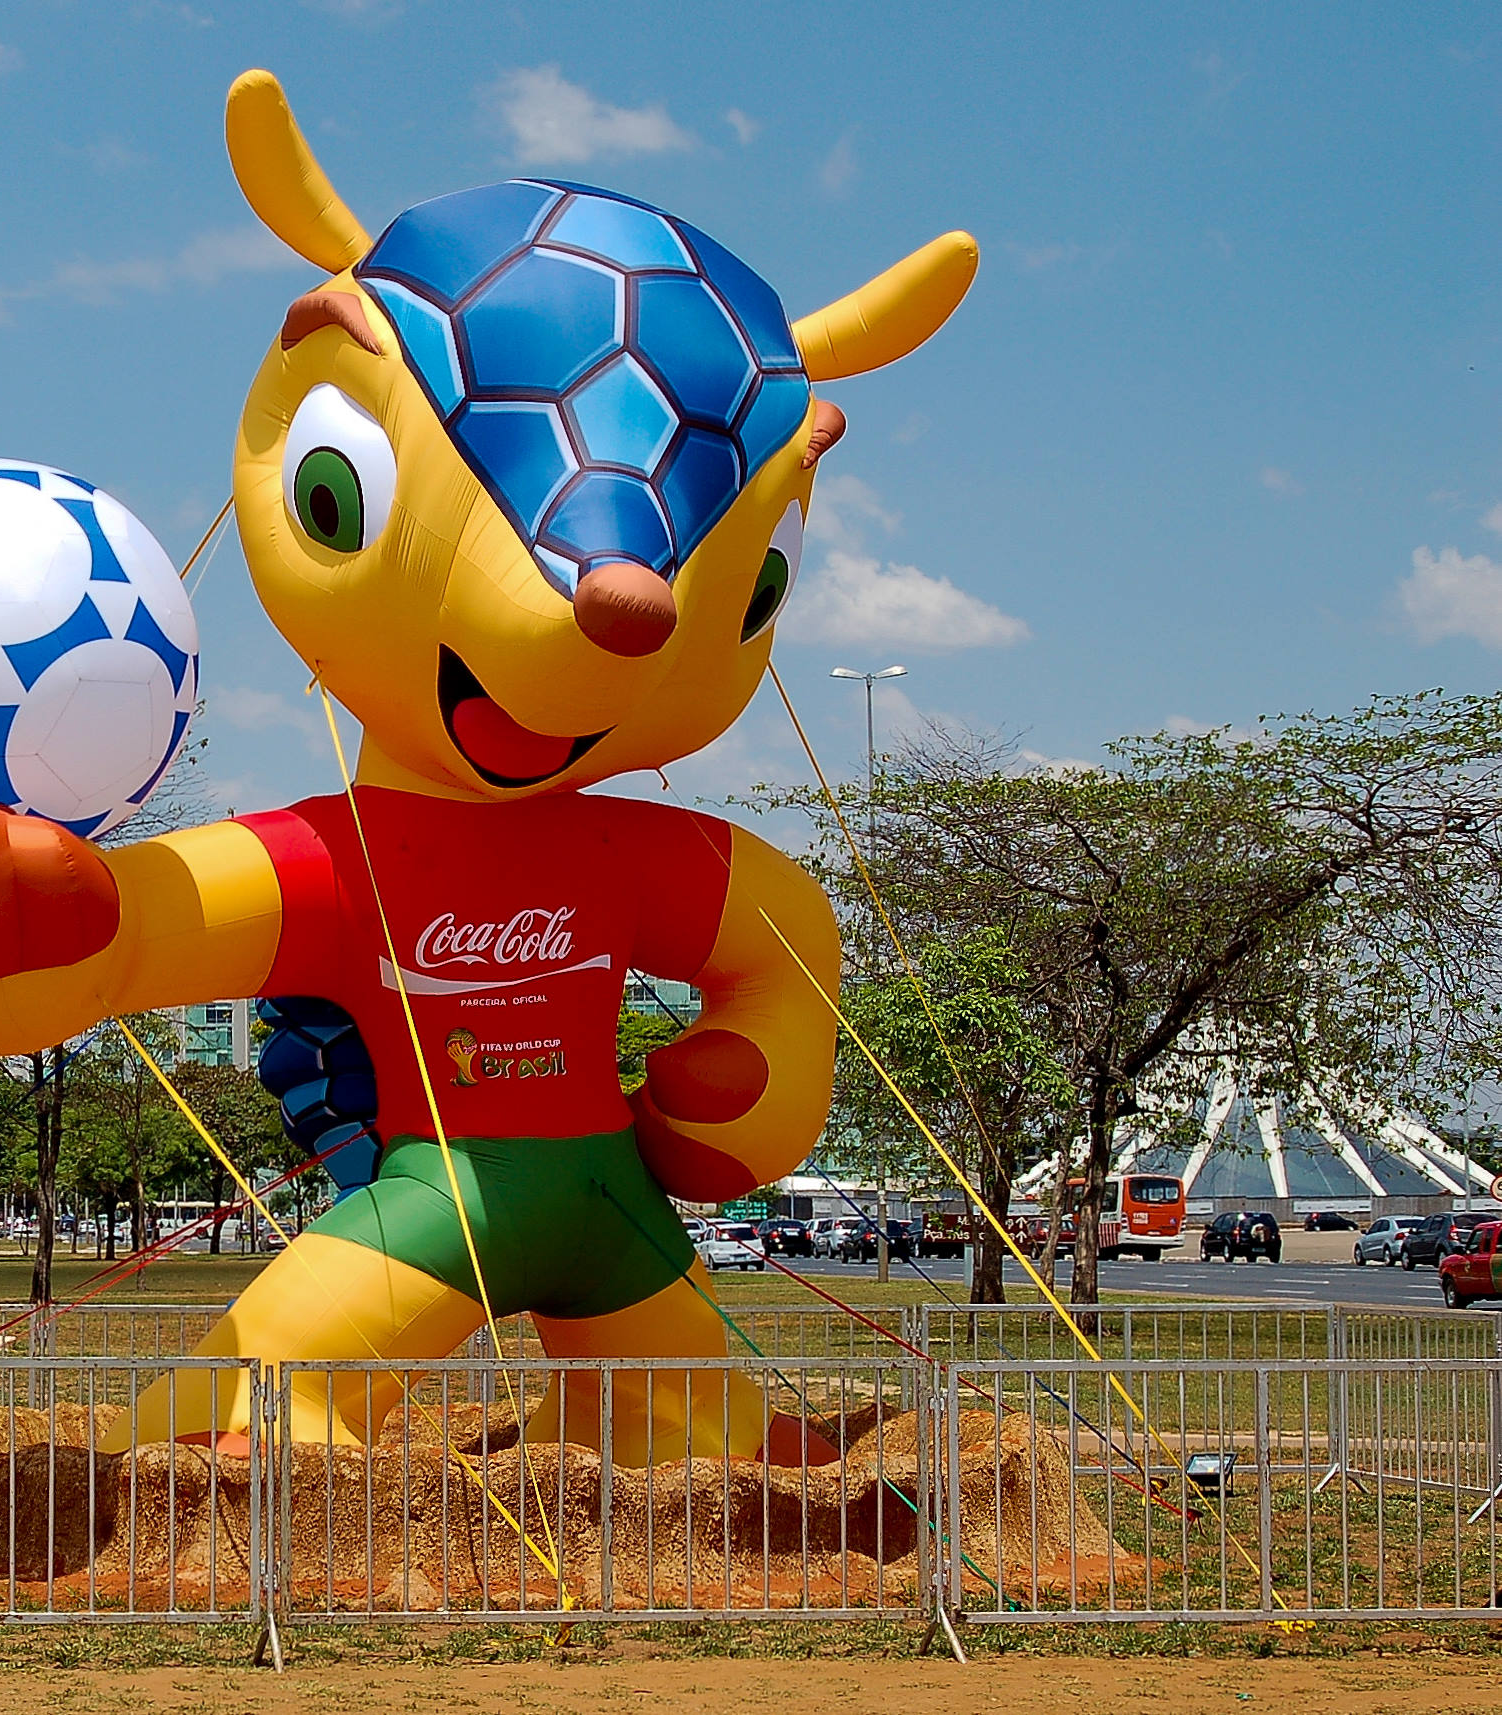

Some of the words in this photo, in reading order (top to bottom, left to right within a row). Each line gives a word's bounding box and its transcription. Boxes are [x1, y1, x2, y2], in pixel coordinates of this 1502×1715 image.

[415, 906, 576, 968] Coca-Cola
[512, 994, 548, 1005] OFICIAL
[480, 1043, 502, 1052] FIFA
[502, 1040, 542, 1051] WORLD
[543, 1039, 561, 1048] CUP
[481, 1051, 567, 1079] Brasil
